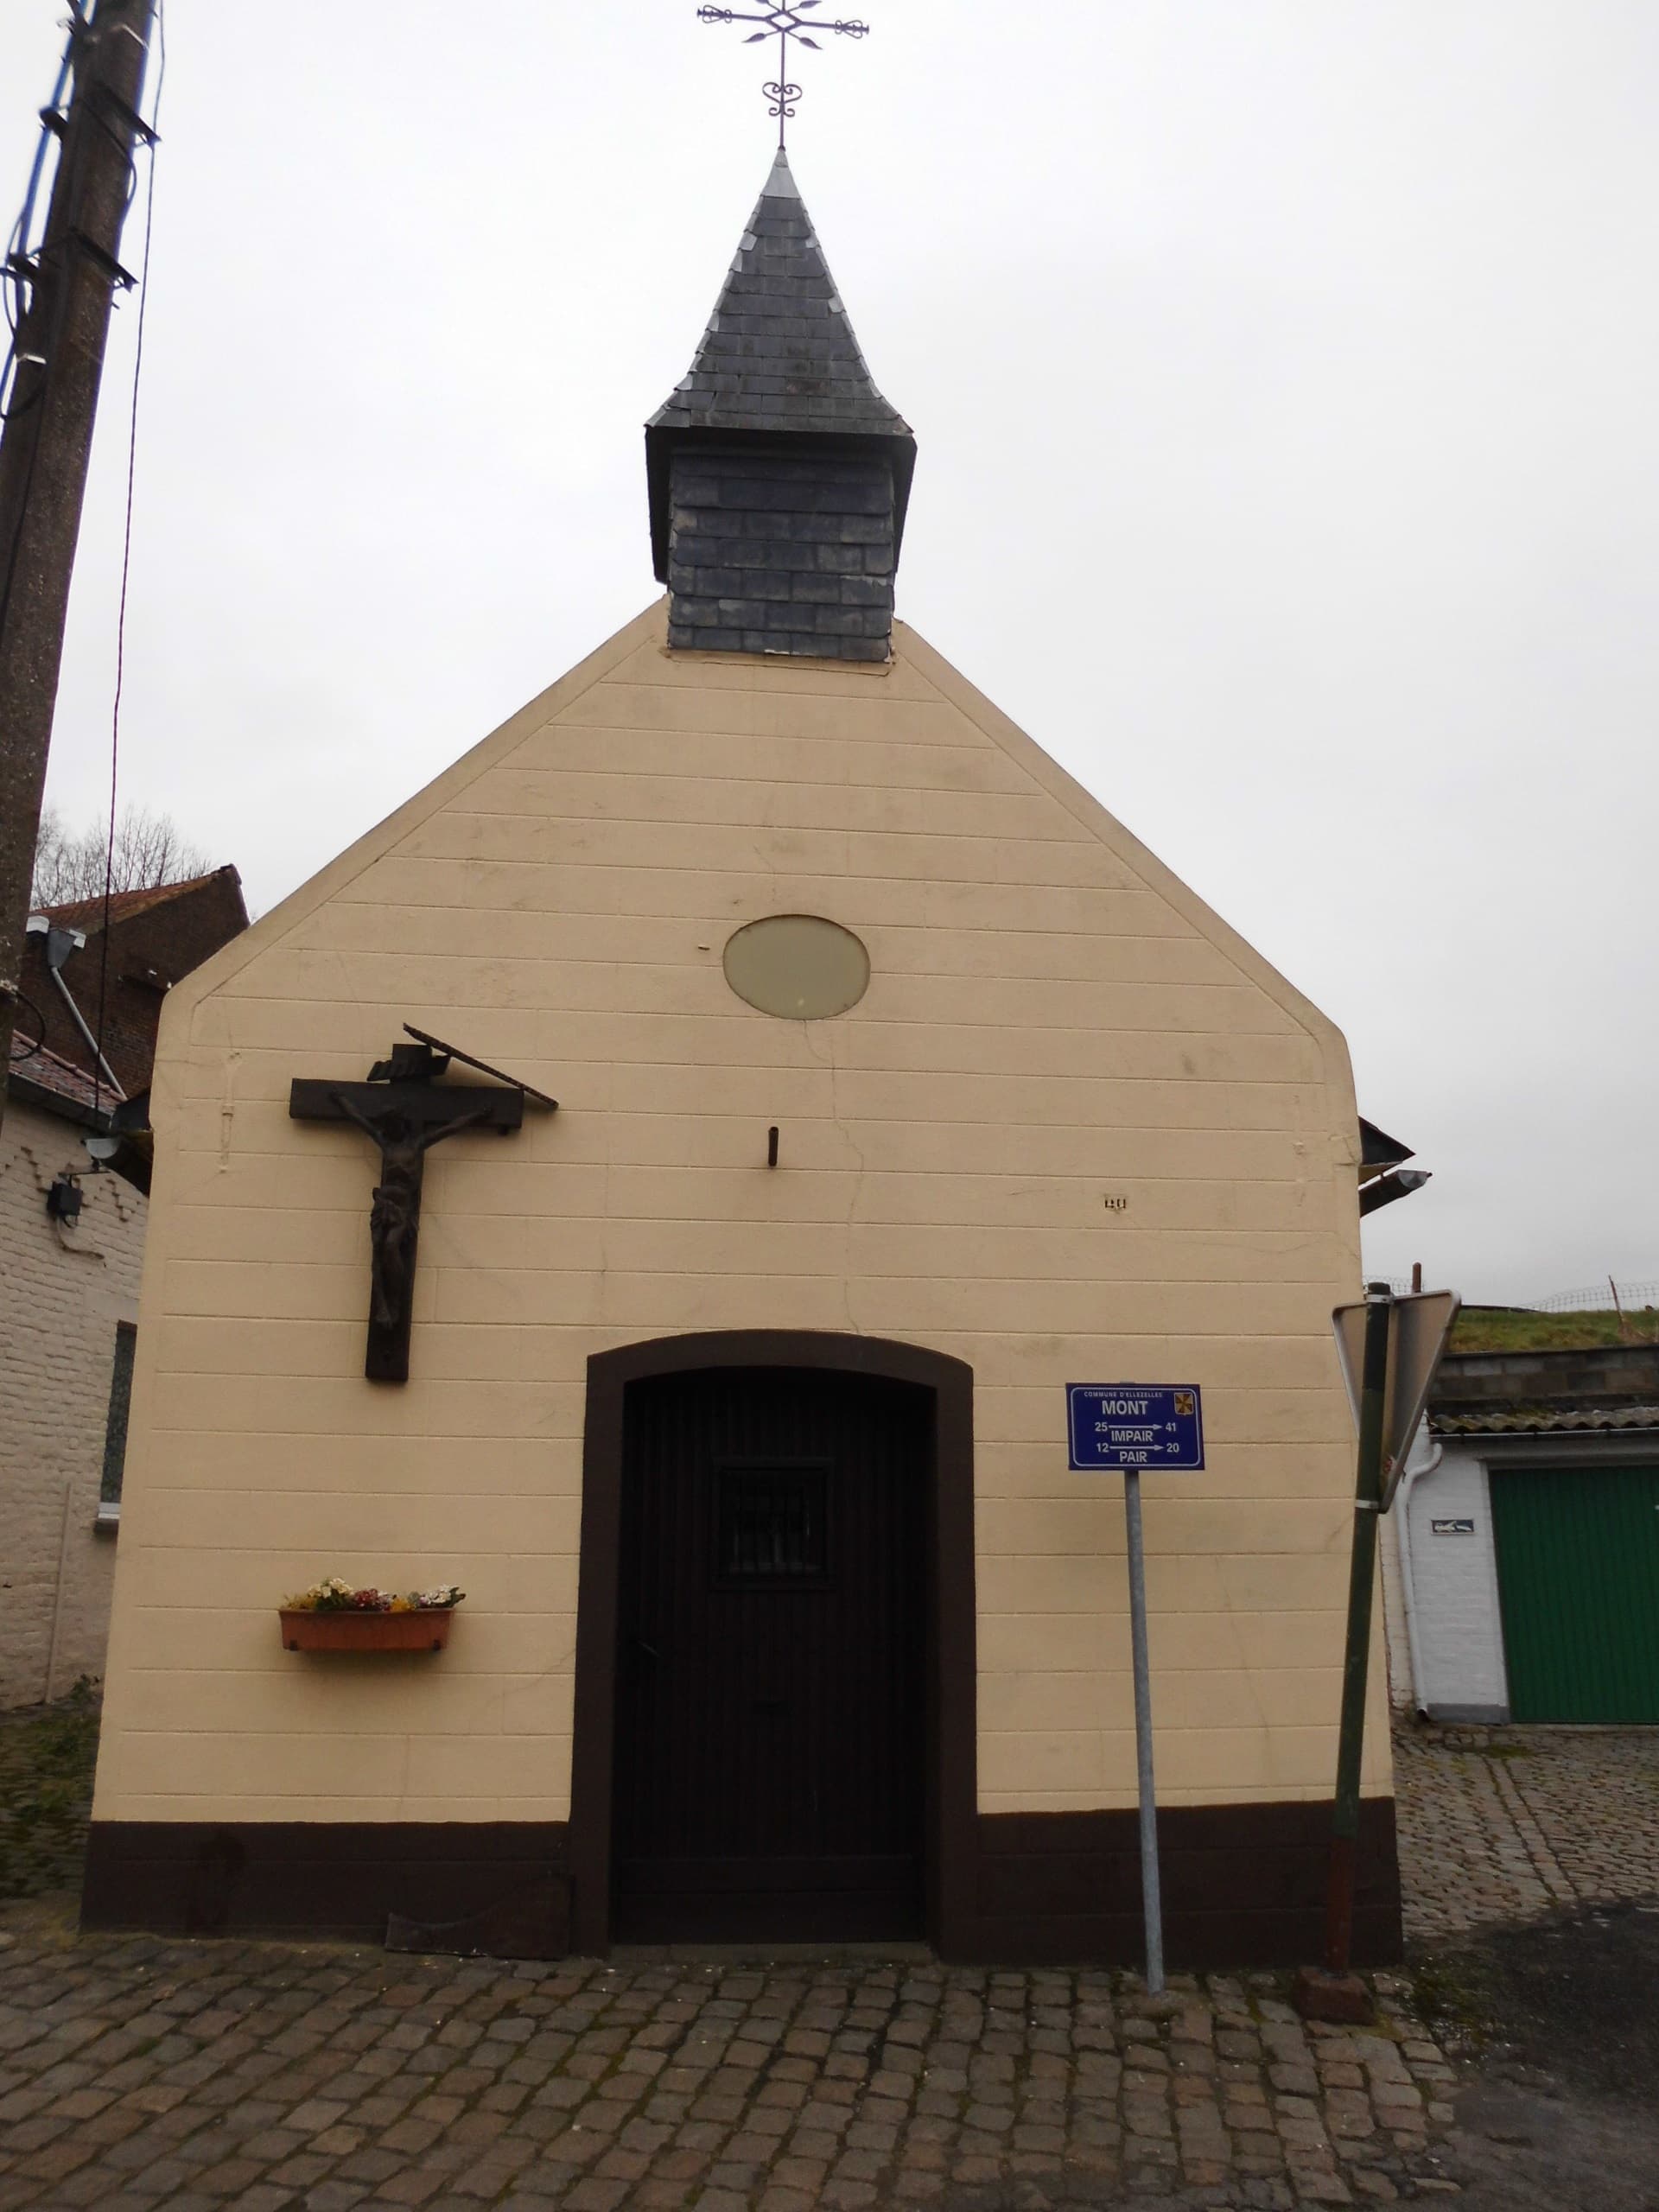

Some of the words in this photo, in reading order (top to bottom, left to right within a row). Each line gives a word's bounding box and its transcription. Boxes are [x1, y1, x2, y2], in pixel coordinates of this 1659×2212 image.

[1102, 1400, 1147, 1415] MONT
[1094, 1421, 1108, 1432] 25
[1165, 1422, 1177, 1432] 41
[1111, 1431, 1154, 1442] IMPAIR
[1096, 1443, 1109, 1452] 12
[1166, 1443, 1179, 1452] 20
[1119, 1451, 1147, 1463] PAIR
